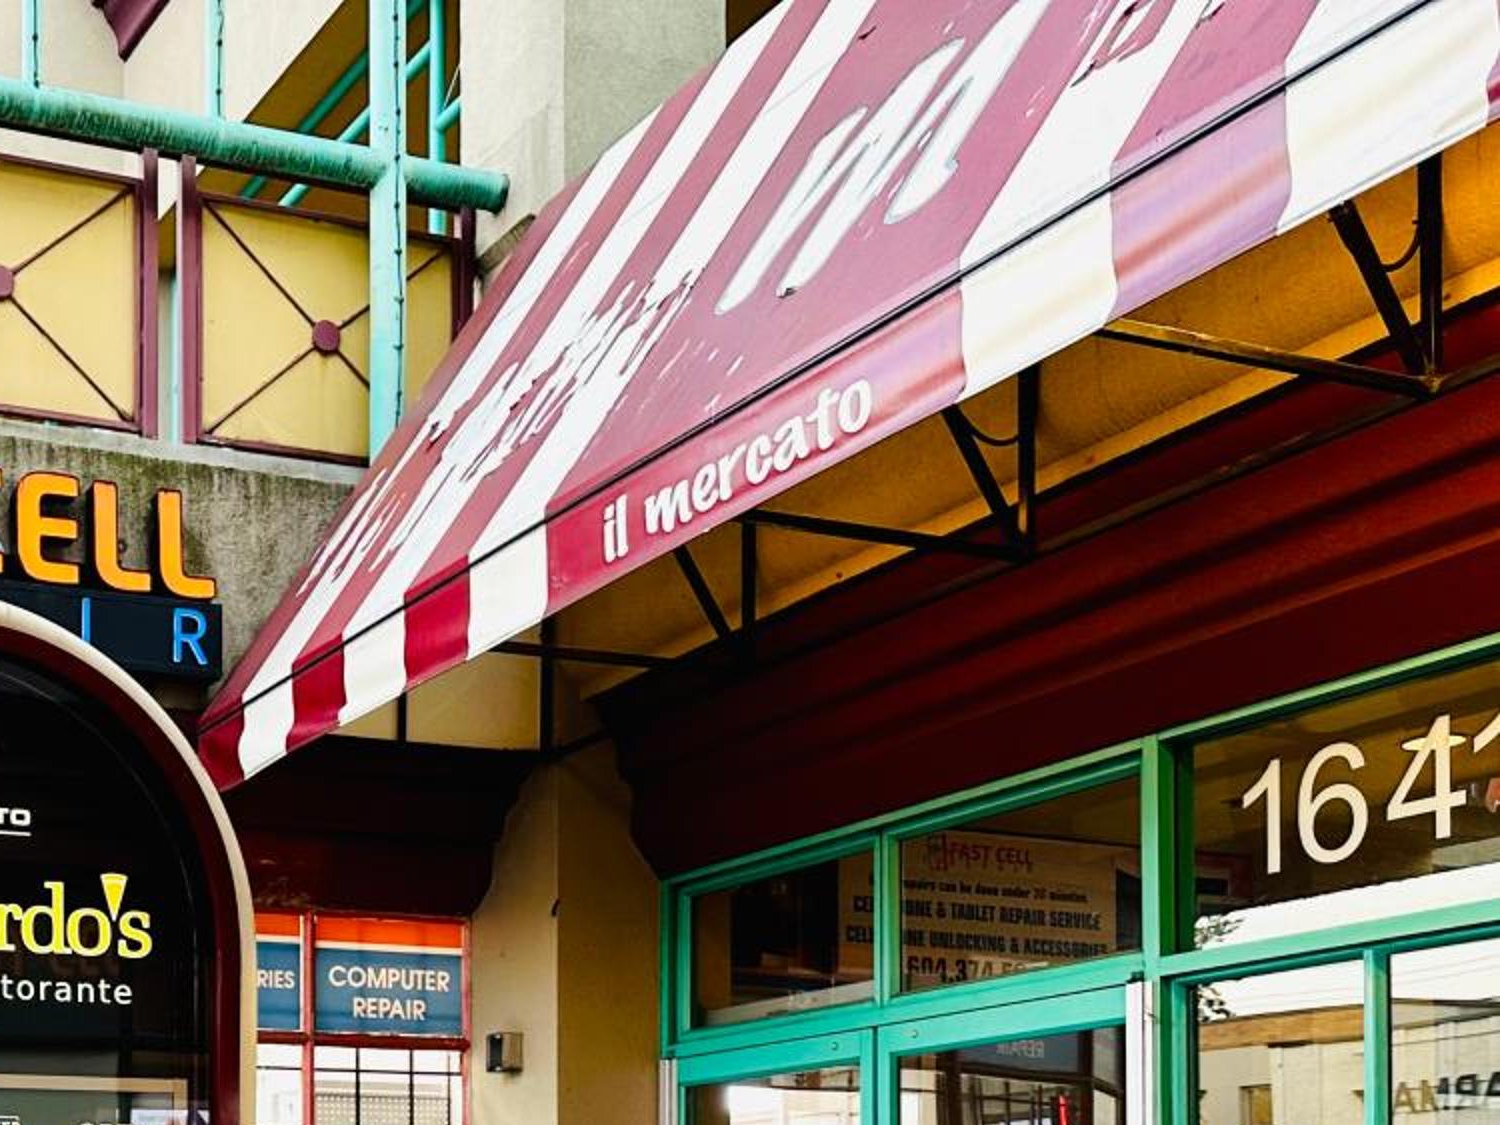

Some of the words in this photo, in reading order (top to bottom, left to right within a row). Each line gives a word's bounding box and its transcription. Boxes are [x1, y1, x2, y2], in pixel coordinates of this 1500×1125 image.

[603, 493, 629, 564] il
[644, 379, 872, 535] mercato
[328, 965, 450, 992] COMPUTER
[352, 997, 427, 1021] REPAIR
